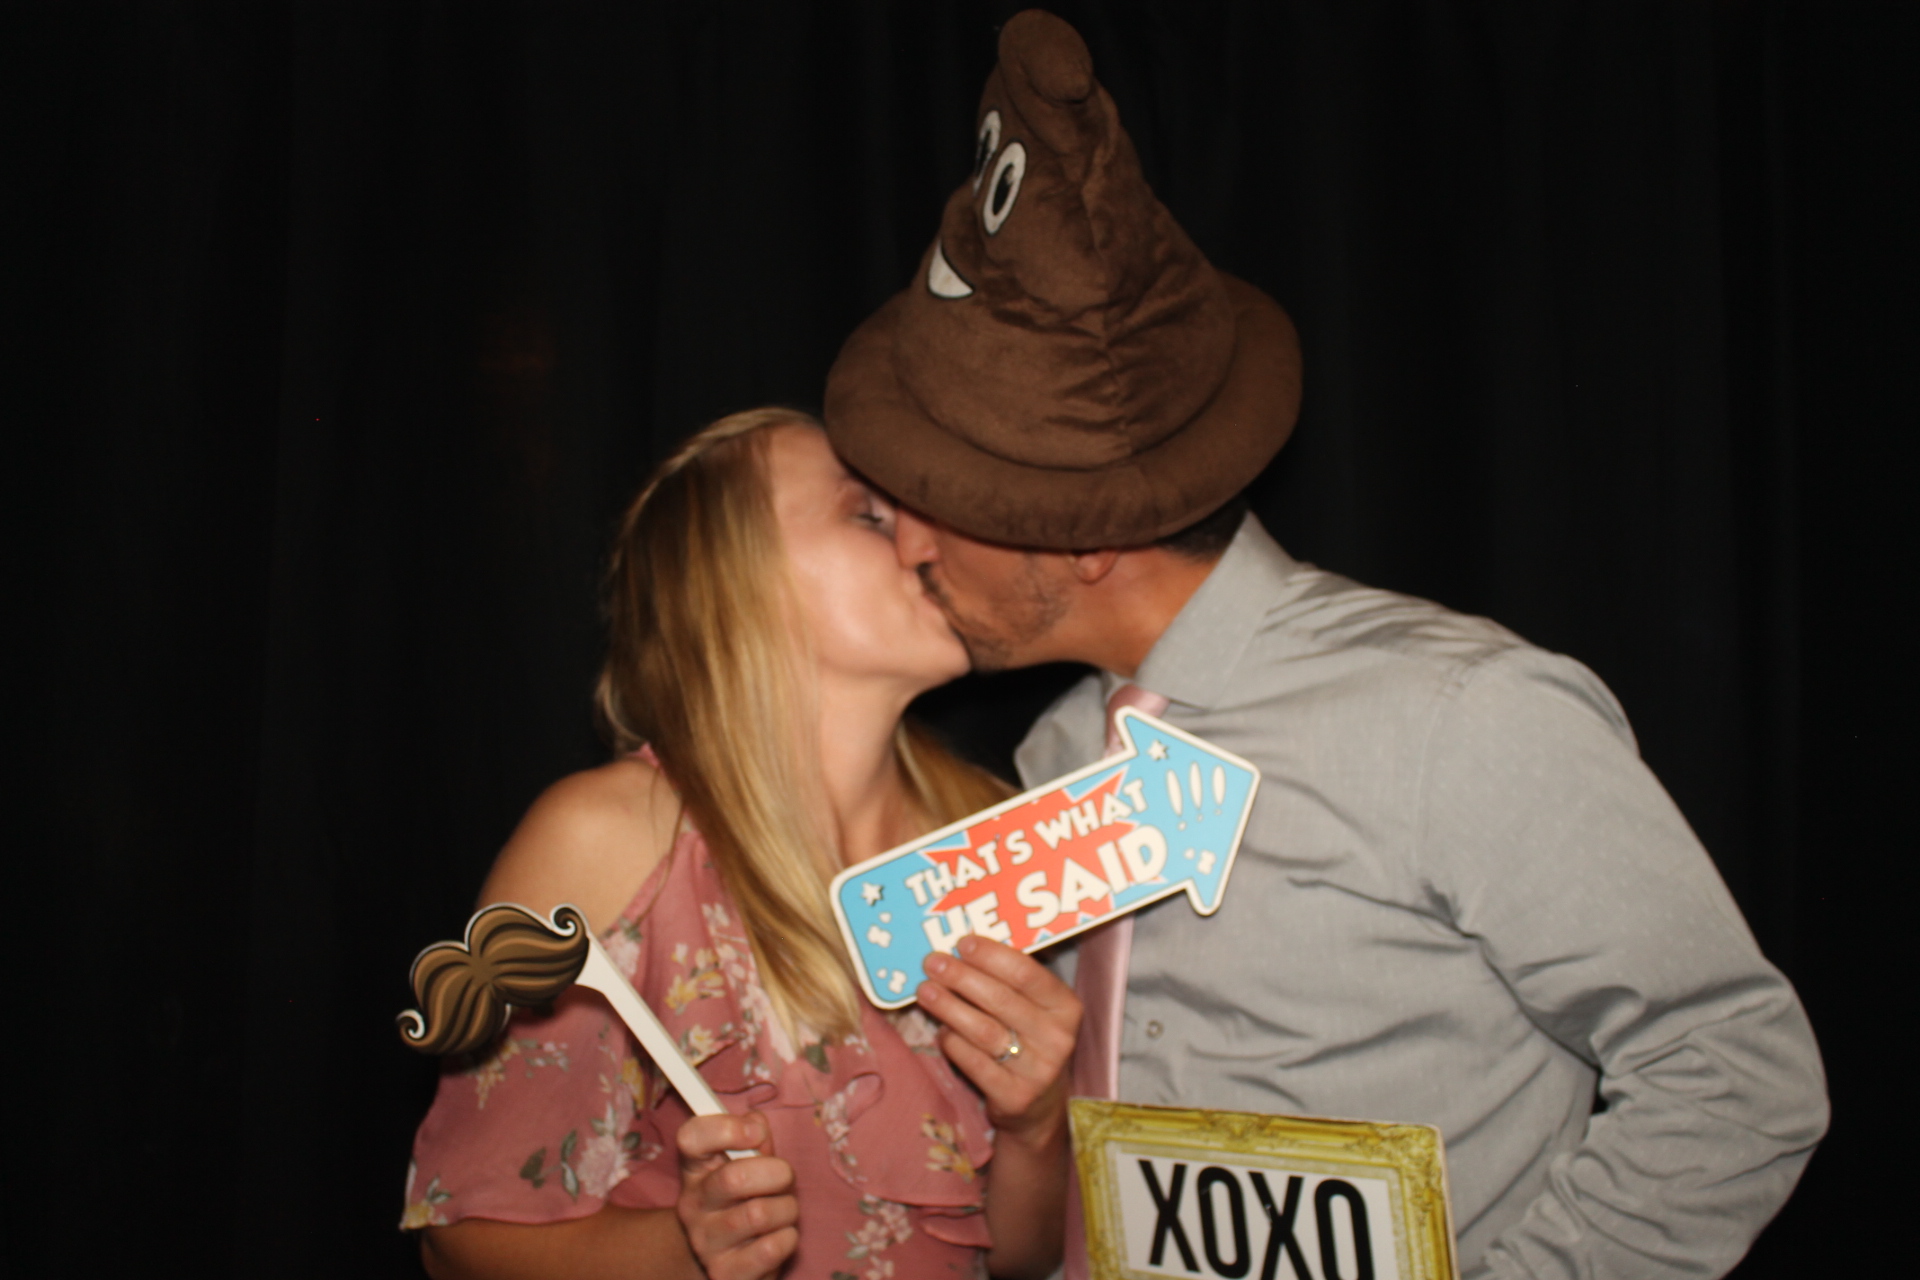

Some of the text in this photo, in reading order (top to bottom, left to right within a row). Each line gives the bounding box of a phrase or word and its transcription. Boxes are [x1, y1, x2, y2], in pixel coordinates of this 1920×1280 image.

[905, 778, 1148, 906] THAT'S WHAT
[921, 824, 1168, 955] HE SAID
[1138, 1159, 1374, 1280] XOXO
